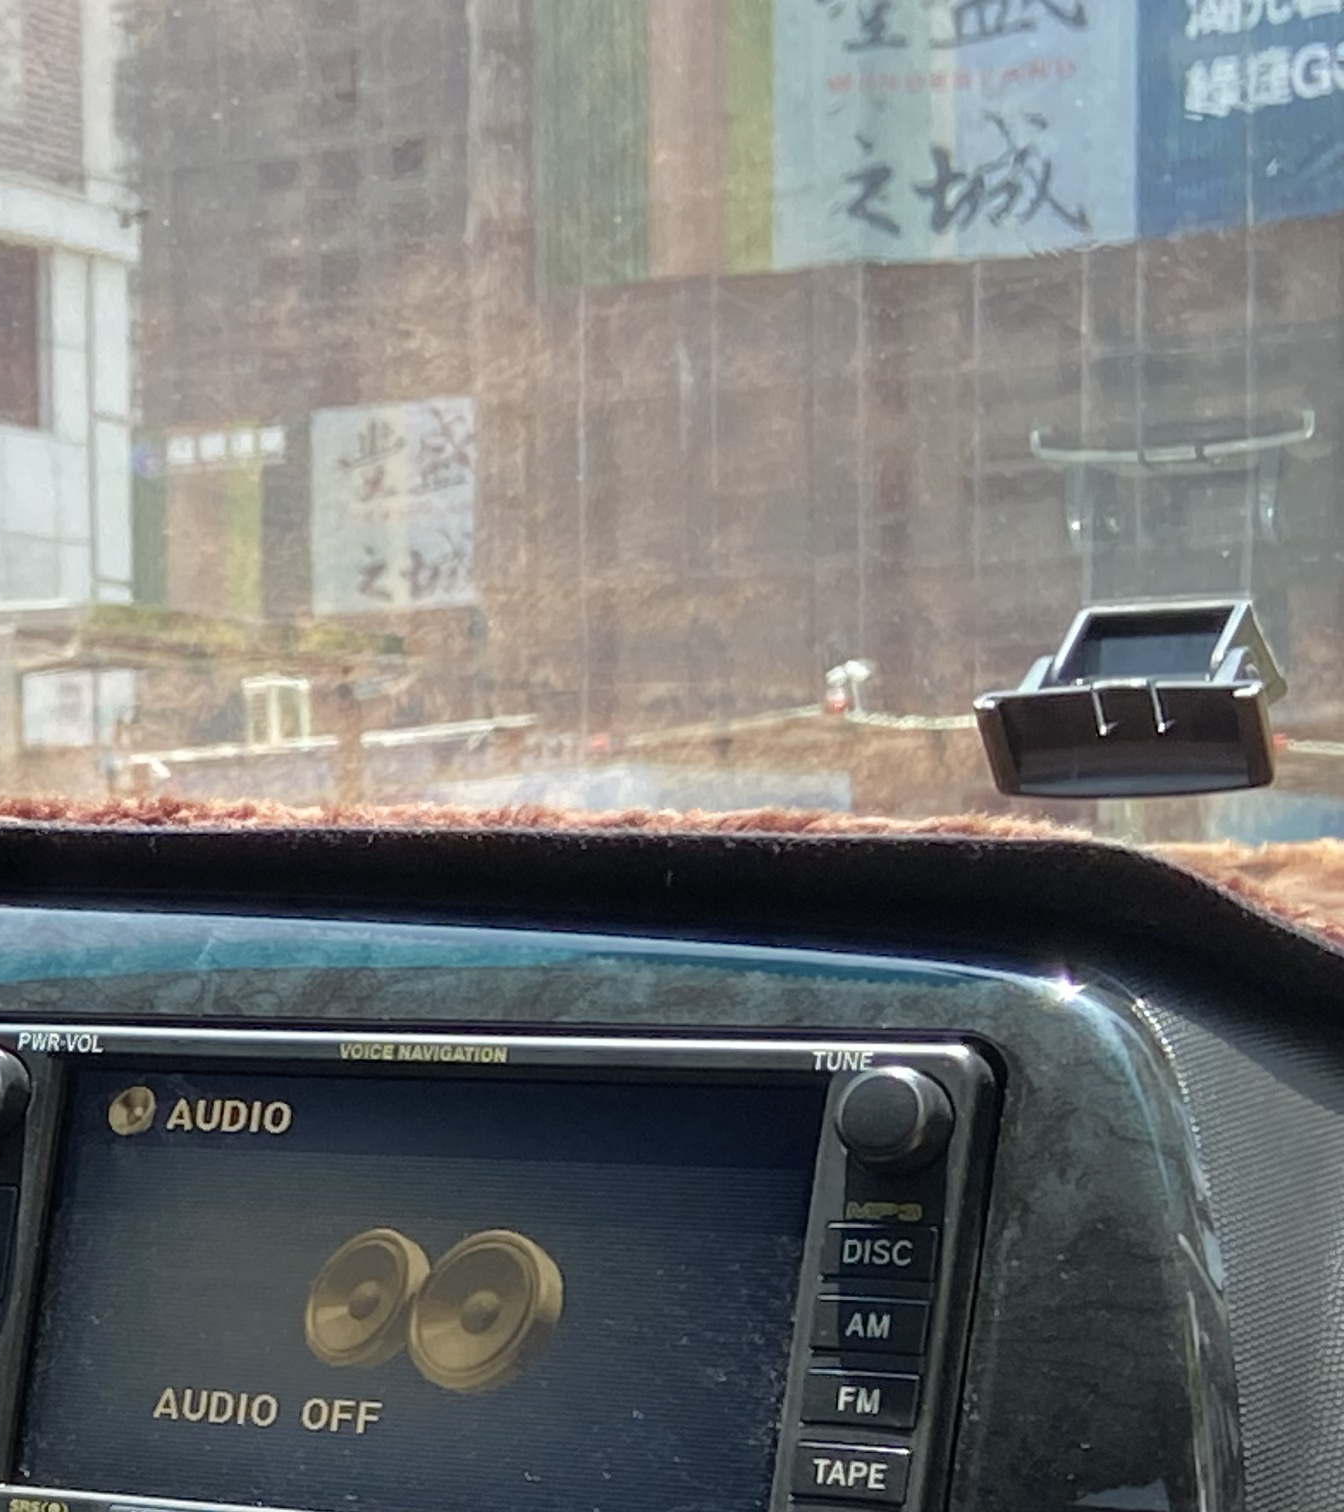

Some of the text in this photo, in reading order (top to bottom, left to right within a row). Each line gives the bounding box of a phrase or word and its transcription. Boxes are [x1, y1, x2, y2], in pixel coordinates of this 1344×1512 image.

[339, 1043, 508, 1064] VOICE NAVIGATION
[813, 1051, 874, 1072] TUNE
[165, 1098, 292, 1134] AUDIO
[842, 1238, 913, 1267] DISC
[845, 1311, 890, 1338] AM
[153, 1386, 383, 1434] AUDIO OFF
[836, 1387, 880, 1415] FM
[812, 1458, 889, 1490] TAPE
